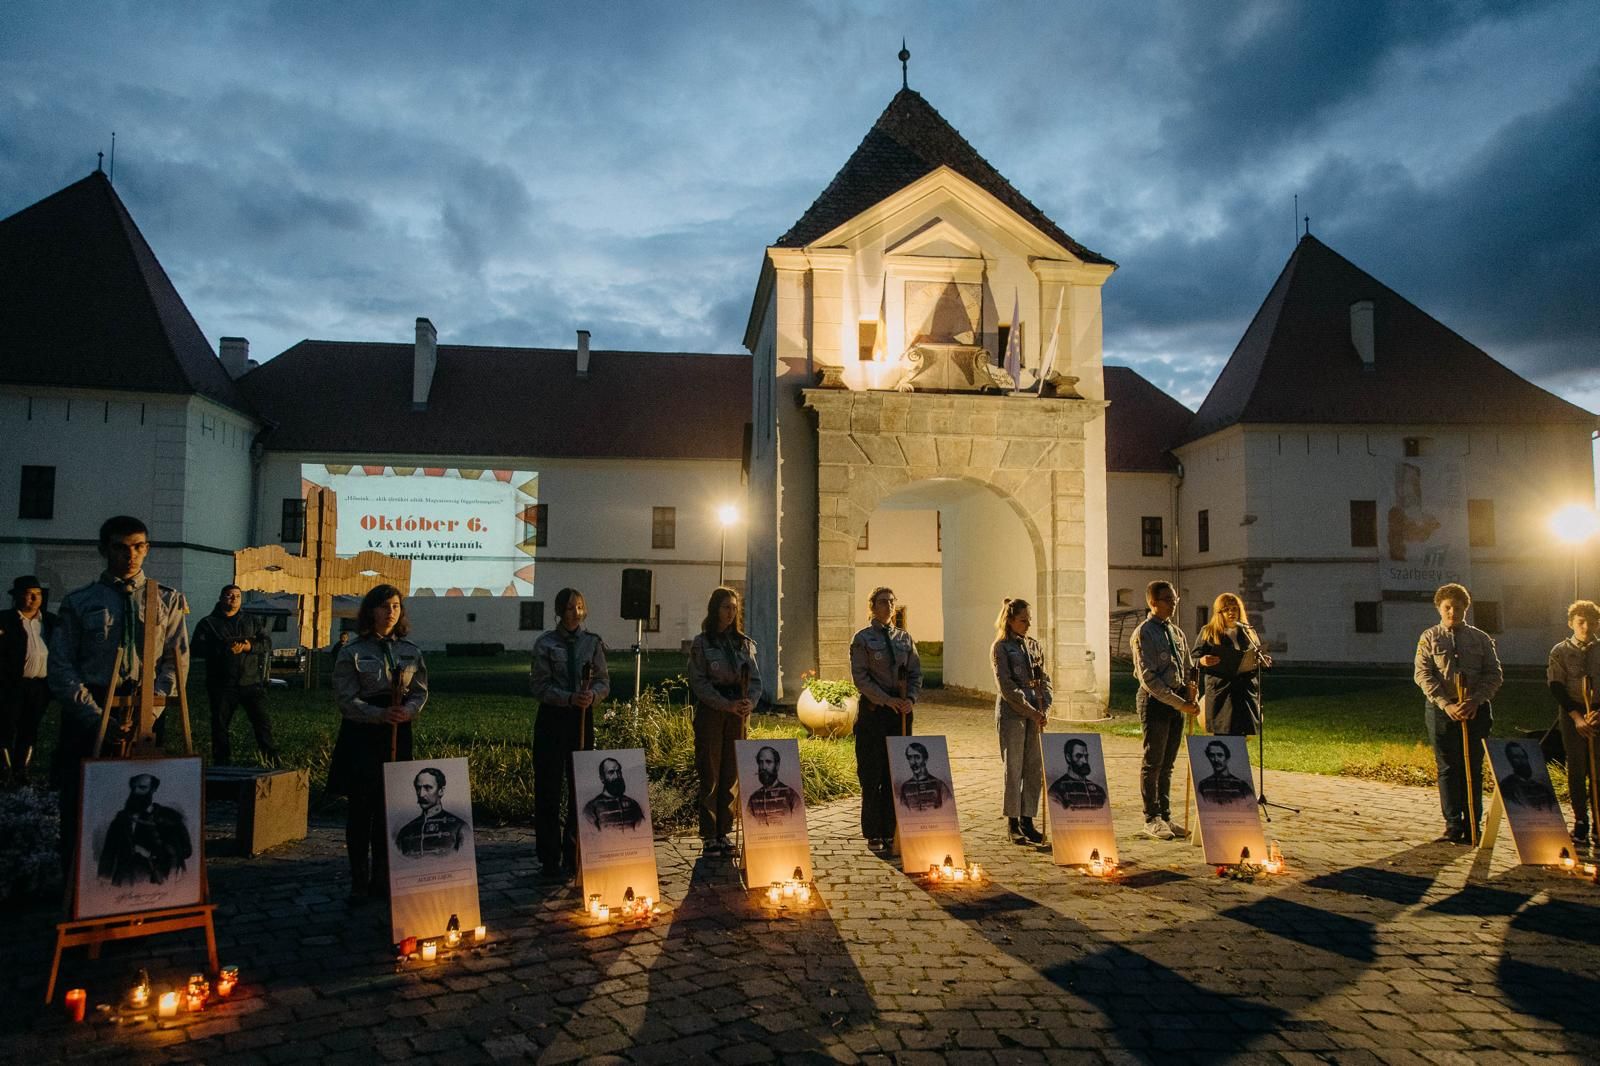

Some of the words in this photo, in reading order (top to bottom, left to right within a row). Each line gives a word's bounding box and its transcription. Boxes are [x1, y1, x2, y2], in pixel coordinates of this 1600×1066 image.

[360, 514, 460, 532] Október
[466, 517, 489, 532] 6.
[367, 539, 383, 548] Az
[387, 539, 422, 549] Aradi
[426, 538, 483, 549] Vértanúk
